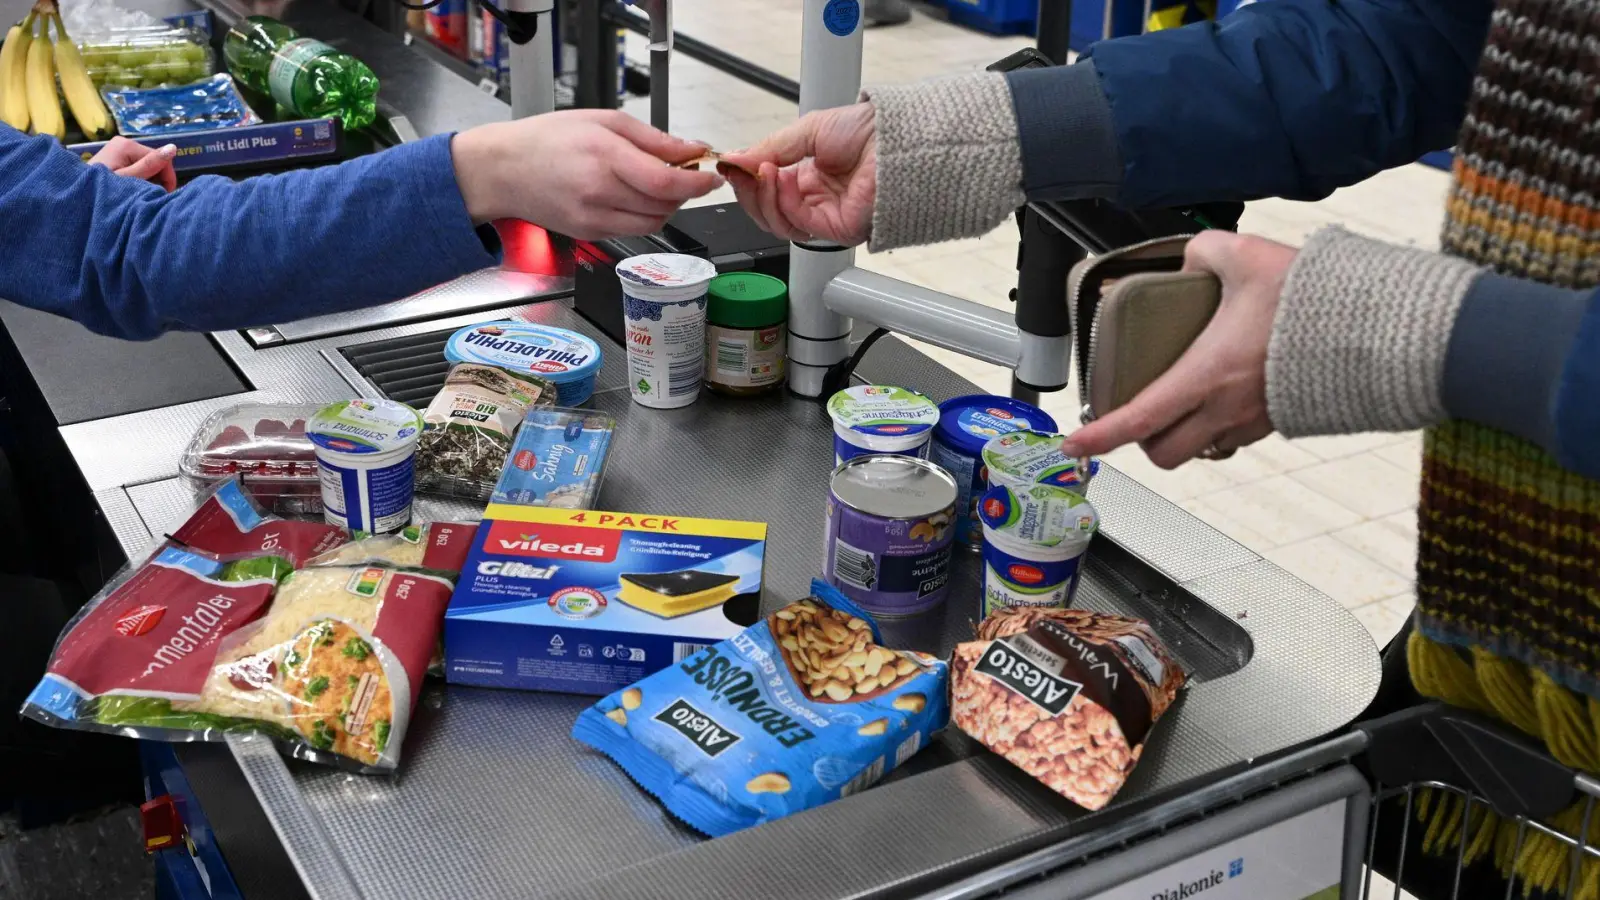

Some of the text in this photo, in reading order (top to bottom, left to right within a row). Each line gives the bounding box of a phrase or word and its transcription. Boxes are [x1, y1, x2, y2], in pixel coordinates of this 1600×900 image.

[175, 145, 203, 157] aren
[206, 142, 226, 153] mit
[227, 137, 250, 151] Lidl
[251, 136, 277, 148] Plus
[463, 331, 589, 366] PHILADELPHIA
[453, 410, 486, 421] Alesto
[332, 422, 388, 441] Schmand
[532, 441, 573, 483] Sahnig
[569, 512, 680, 531] 4 PACK
[436, 534, 448, 546] 250
[499, 537, 605, 557] vileda
[475, 575, 498, 583] PLUS
[477, 560, 562, 580] Glitzi
[395, 584, 412, 600] 250
[988, 648, 1069, 705] Alesto
[680, 646, 817, 749] ERDNÜSSE
[671, 704, 730, 747] Alesto
